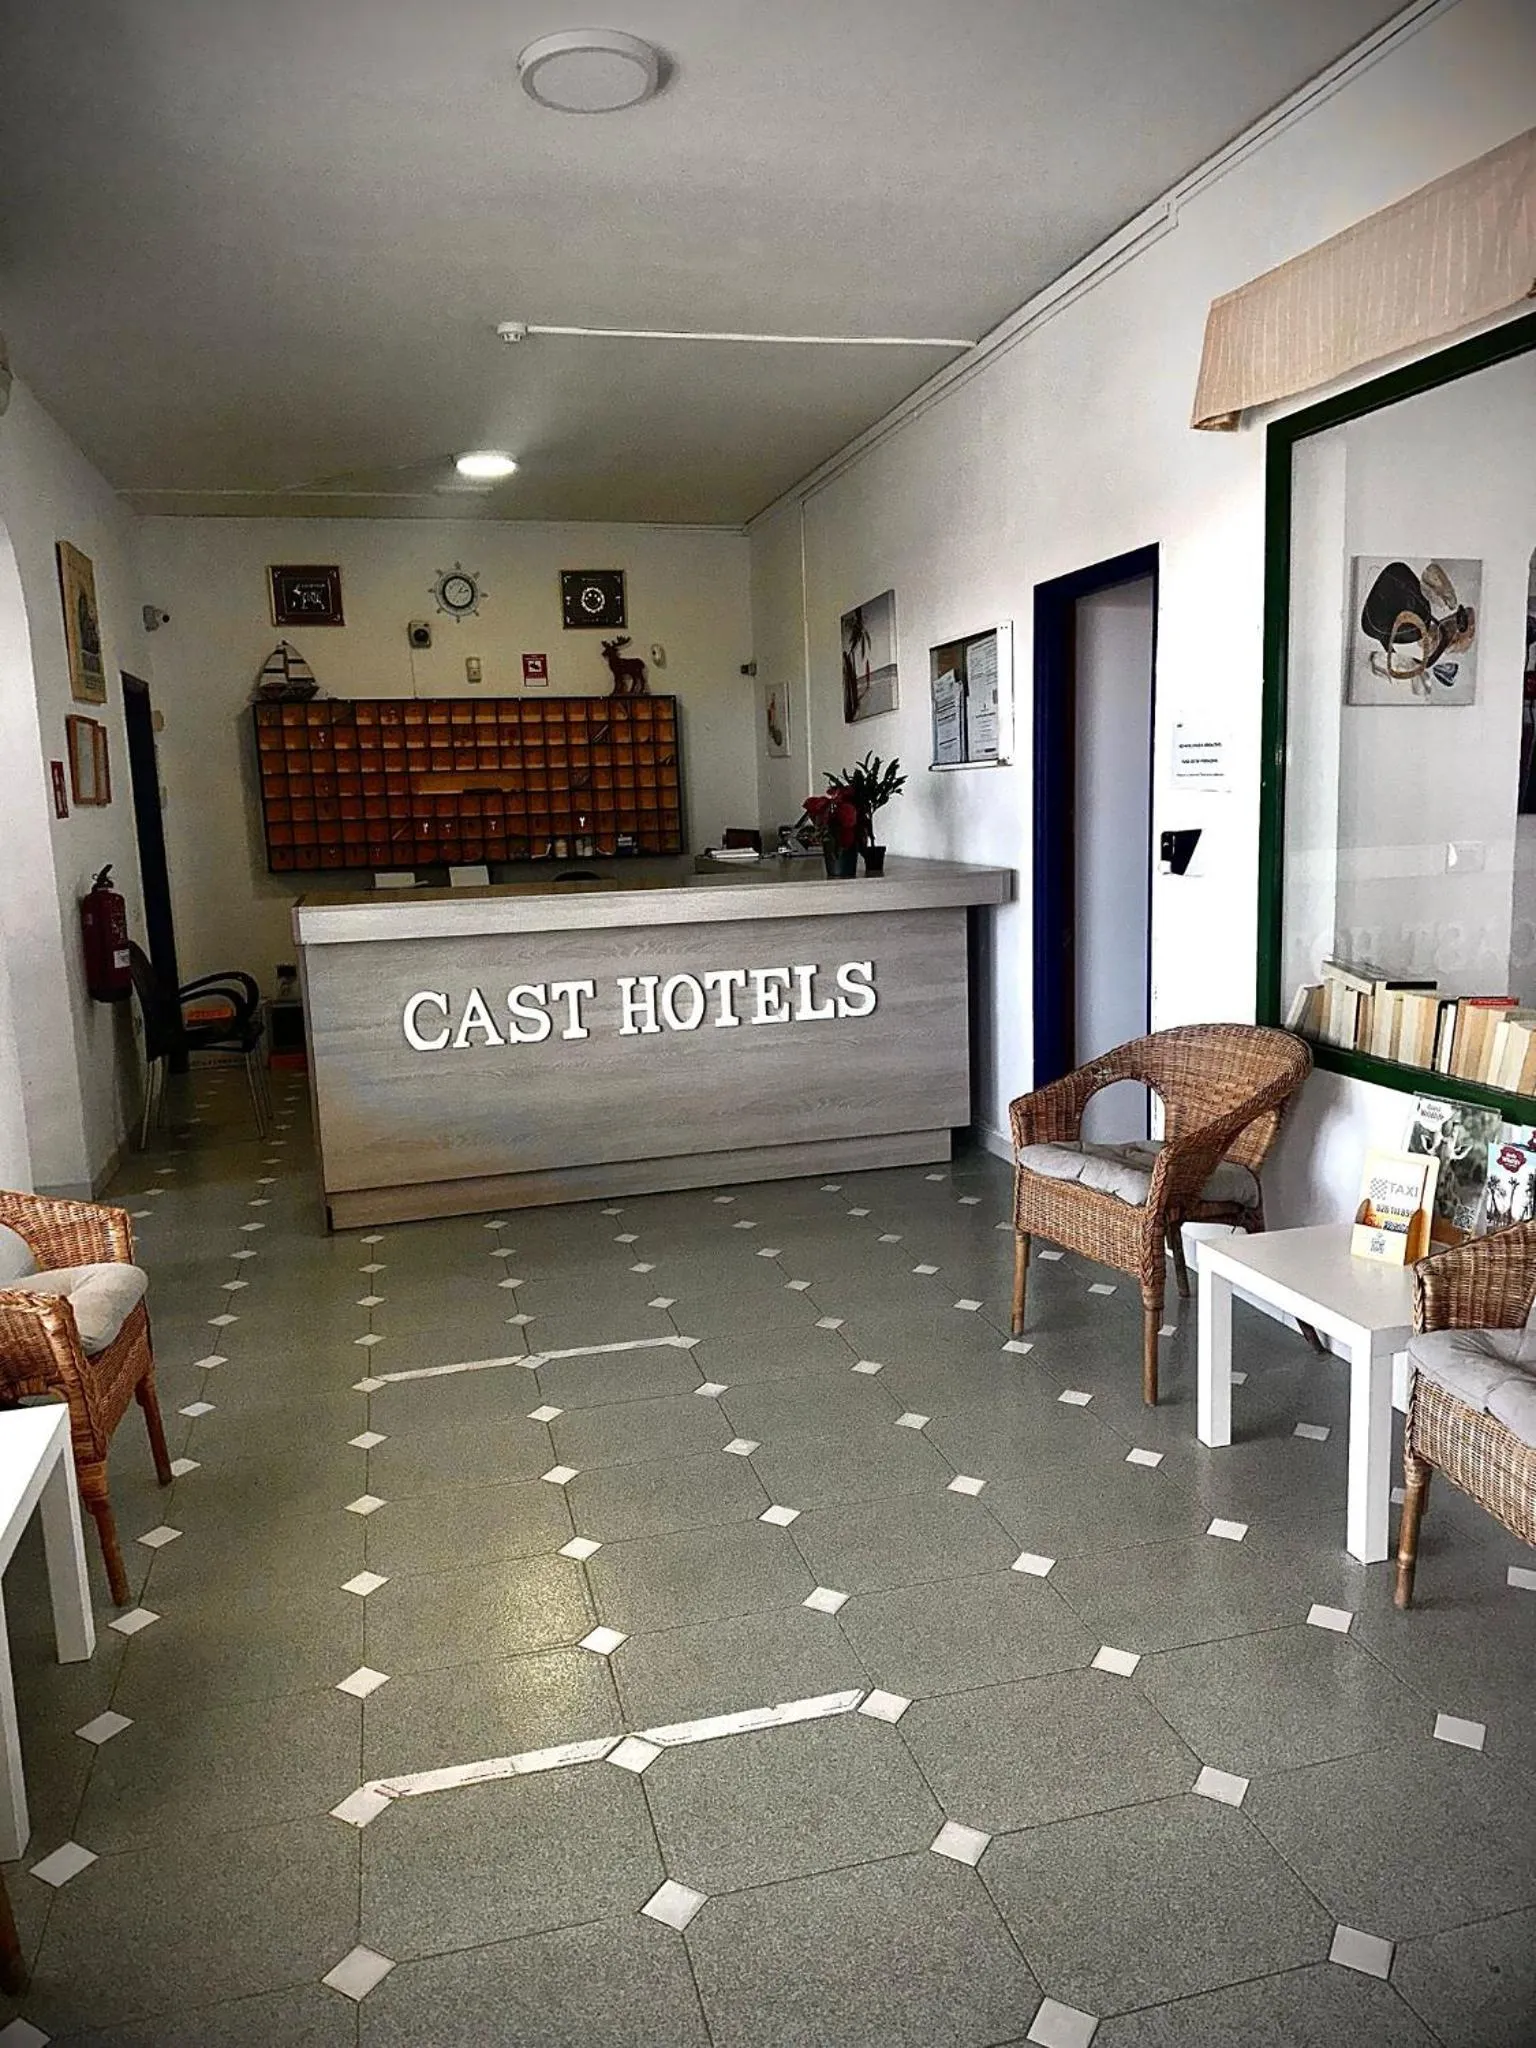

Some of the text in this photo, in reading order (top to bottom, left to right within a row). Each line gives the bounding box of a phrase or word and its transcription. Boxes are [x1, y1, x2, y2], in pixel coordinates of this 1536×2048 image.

[402, 960, 878, 1052] CAST HOTELS
[1388, 1182, 1419, 1197] TAXI
